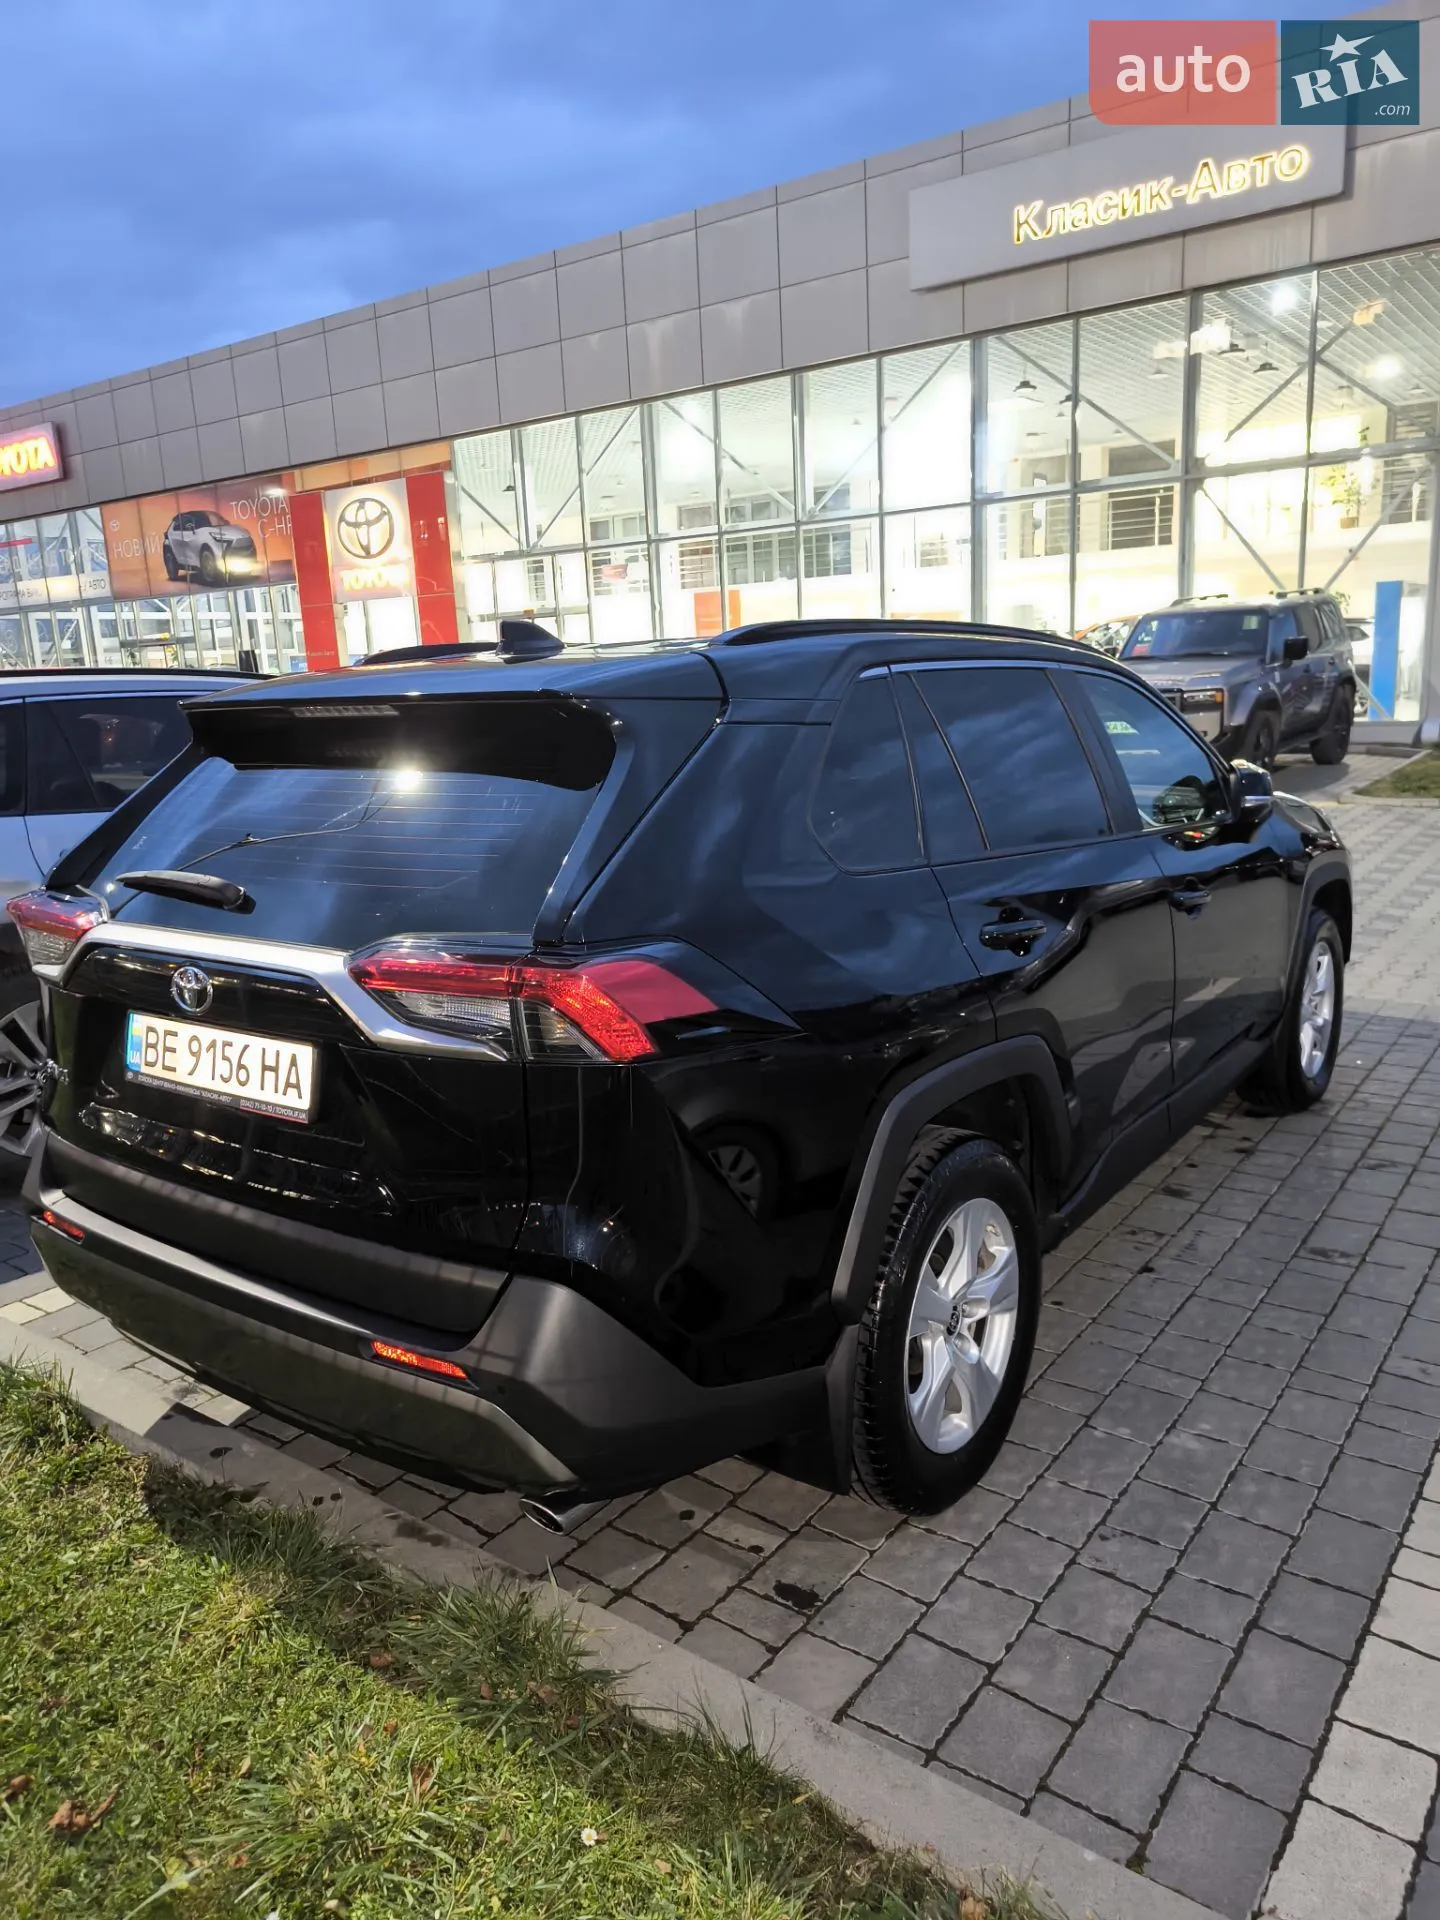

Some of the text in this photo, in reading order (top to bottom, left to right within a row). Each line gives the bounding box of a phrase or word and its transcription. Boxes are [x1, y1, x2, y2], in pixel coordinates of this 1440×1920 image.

[0, 437, 56, 476] YOTA
[230, 495, 288, 521] TOYOTA
[112, 531, 162, 559] НОВИЙ
[130, 1050, 141, 1065] UA
[143, 1025, 303, 1100] BE 9156 HA
